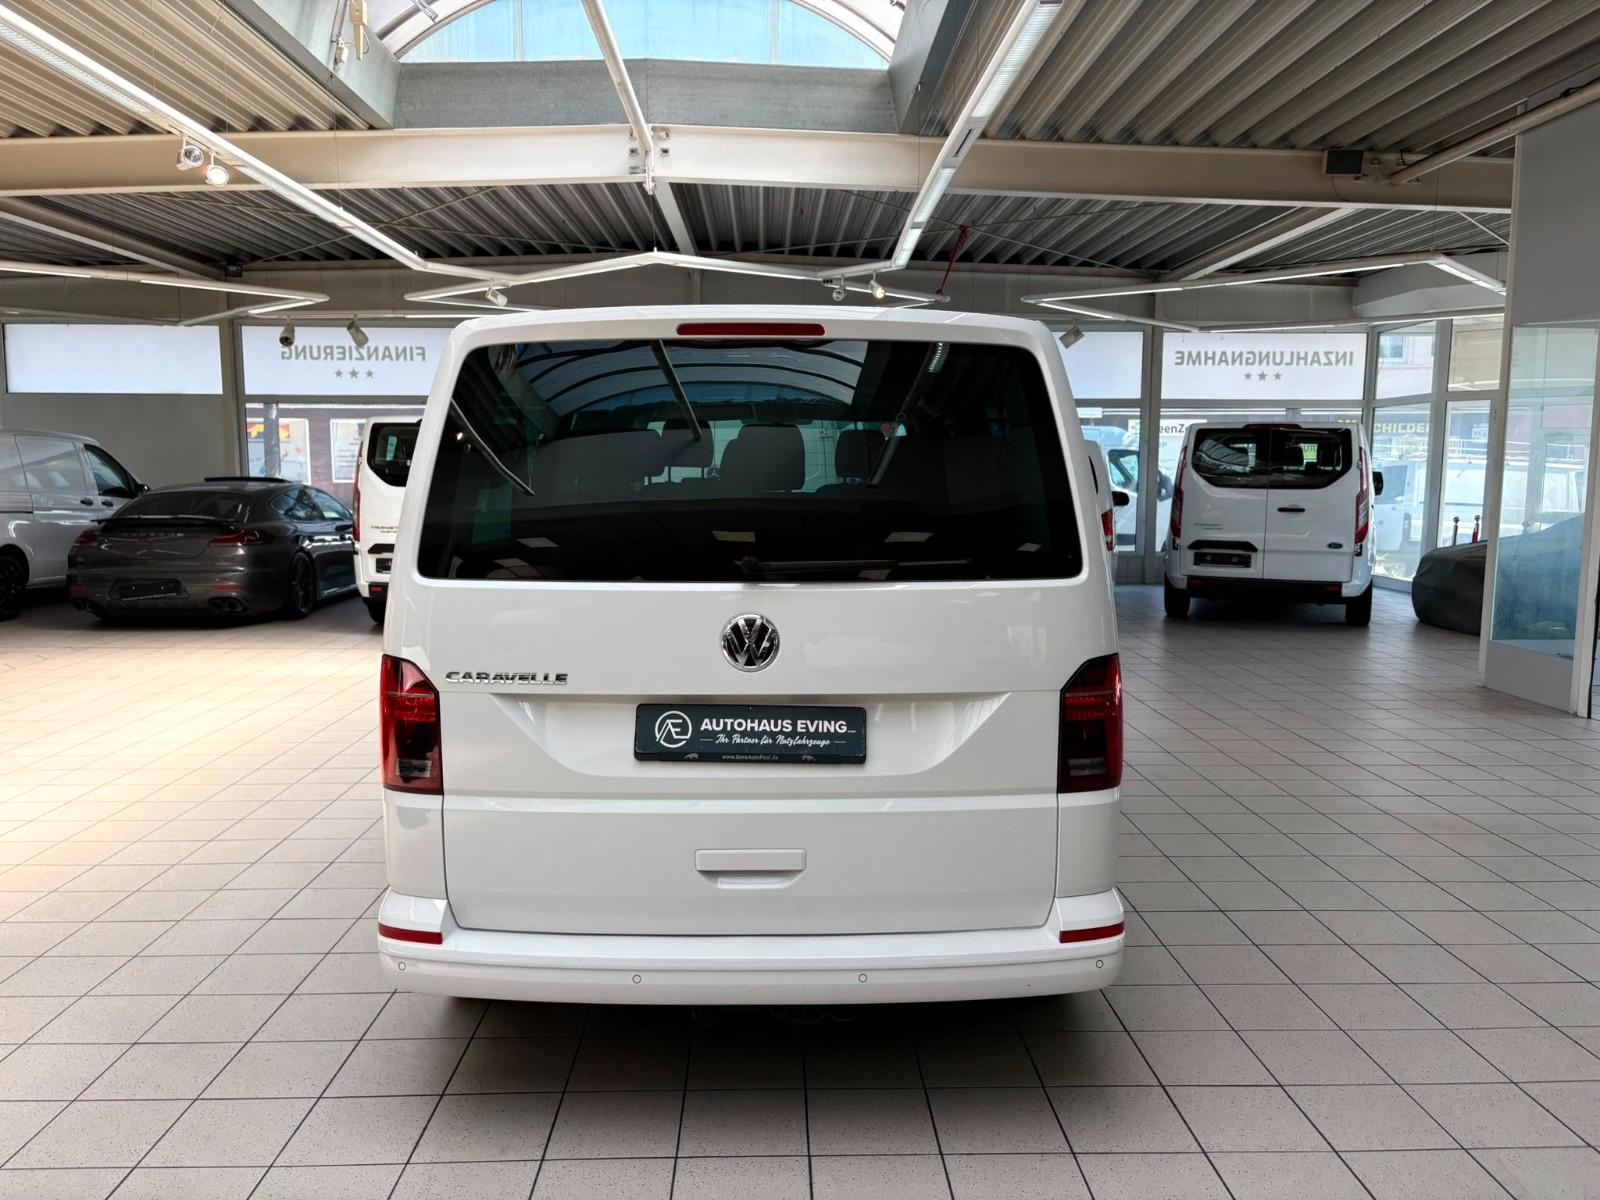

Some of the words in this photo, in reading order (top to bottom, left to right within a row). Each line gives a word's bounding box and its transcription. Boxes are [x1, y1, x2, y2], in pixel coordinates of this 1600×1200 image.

[445, 671, 568, 685] CARAVELLE
[700, 718, 793, 732] AUTOHAUS
[796, 719, 848, 733] EVING
[715, 734, 729, 745] Ihr
[732, 734, 759, 745] Partner
[760, 735, 773, 745] für
[775, 735, 830, 747] Nutzfahrzeuge
